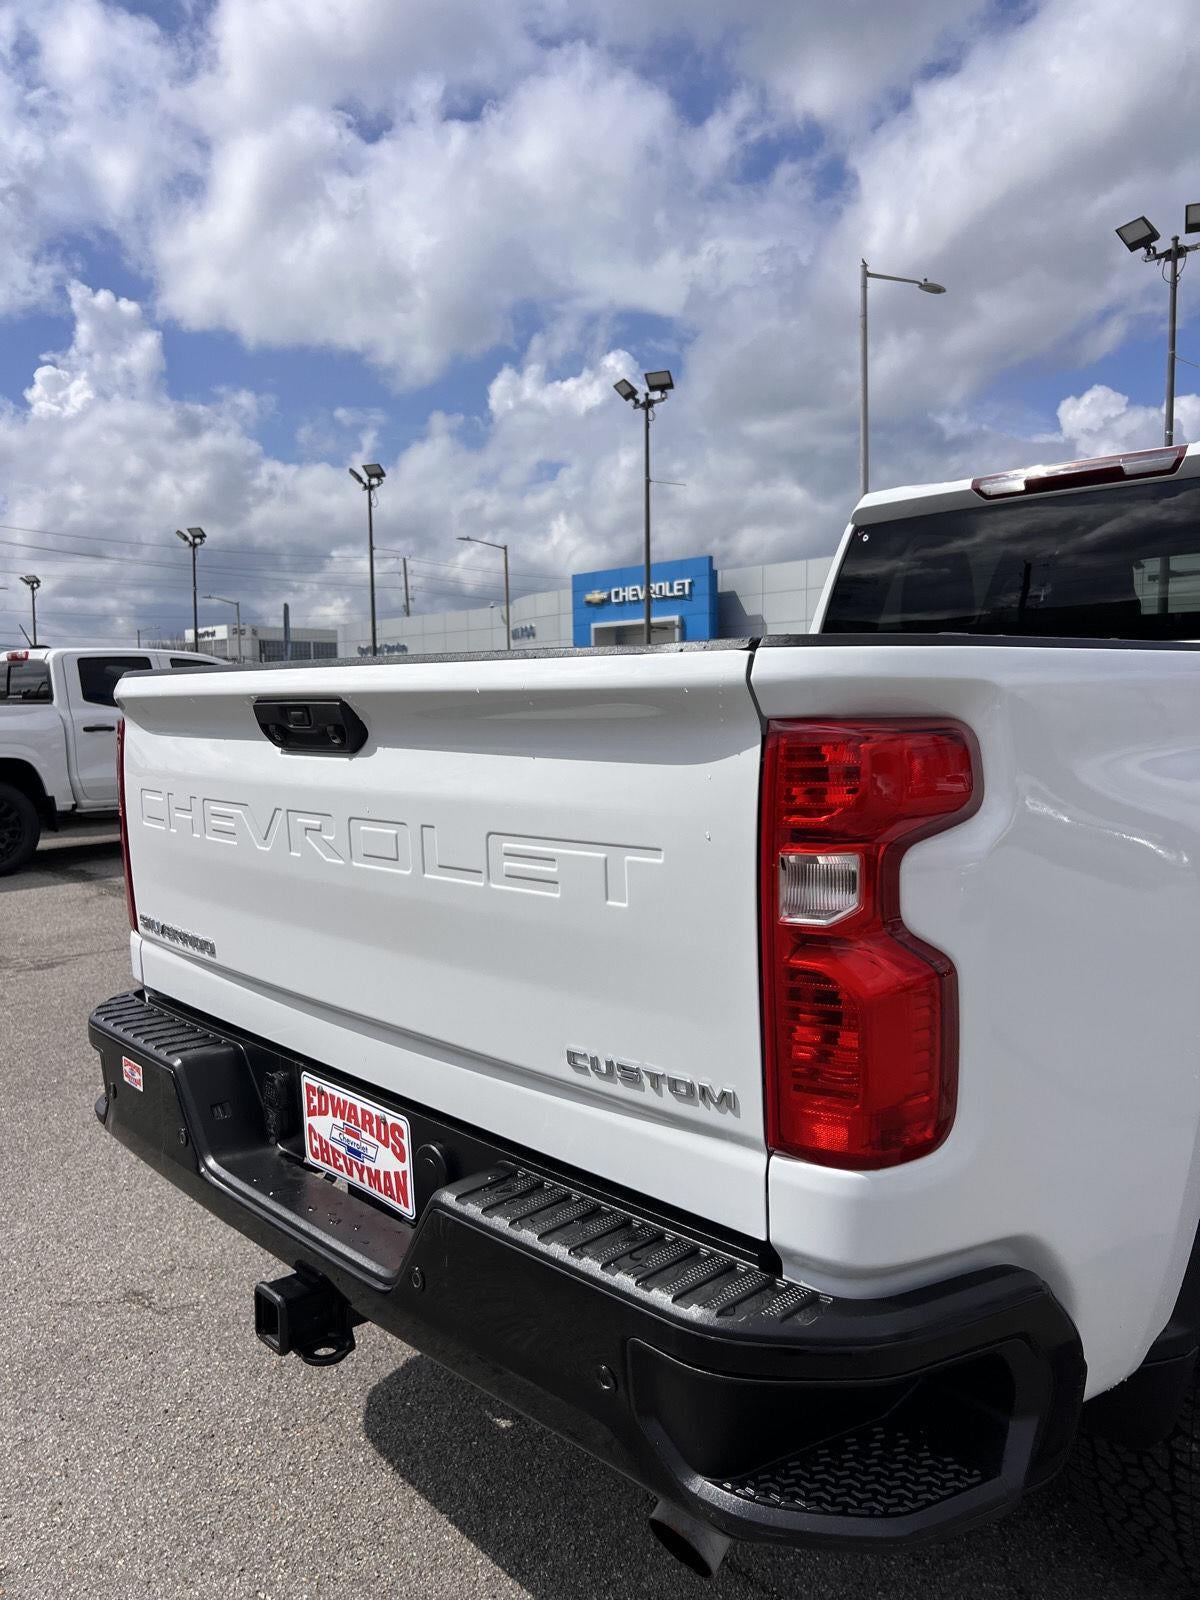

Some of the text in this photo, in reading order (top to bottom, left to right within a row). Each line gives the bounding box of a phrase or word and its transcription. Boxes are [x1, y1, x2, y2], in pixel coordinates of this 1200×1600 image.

[611, 579, 691, 603] CHEVROLET
[141, 788, 664, 907] CHEVROLET
[566, 1049, 738, 1112] CUSTOM
[305, 1082, 407, 1164] EDWARDS
[338, 1132, 369, 1153] Chevrolet
[308, 1122, 410, 1210] CHEVYMAN
